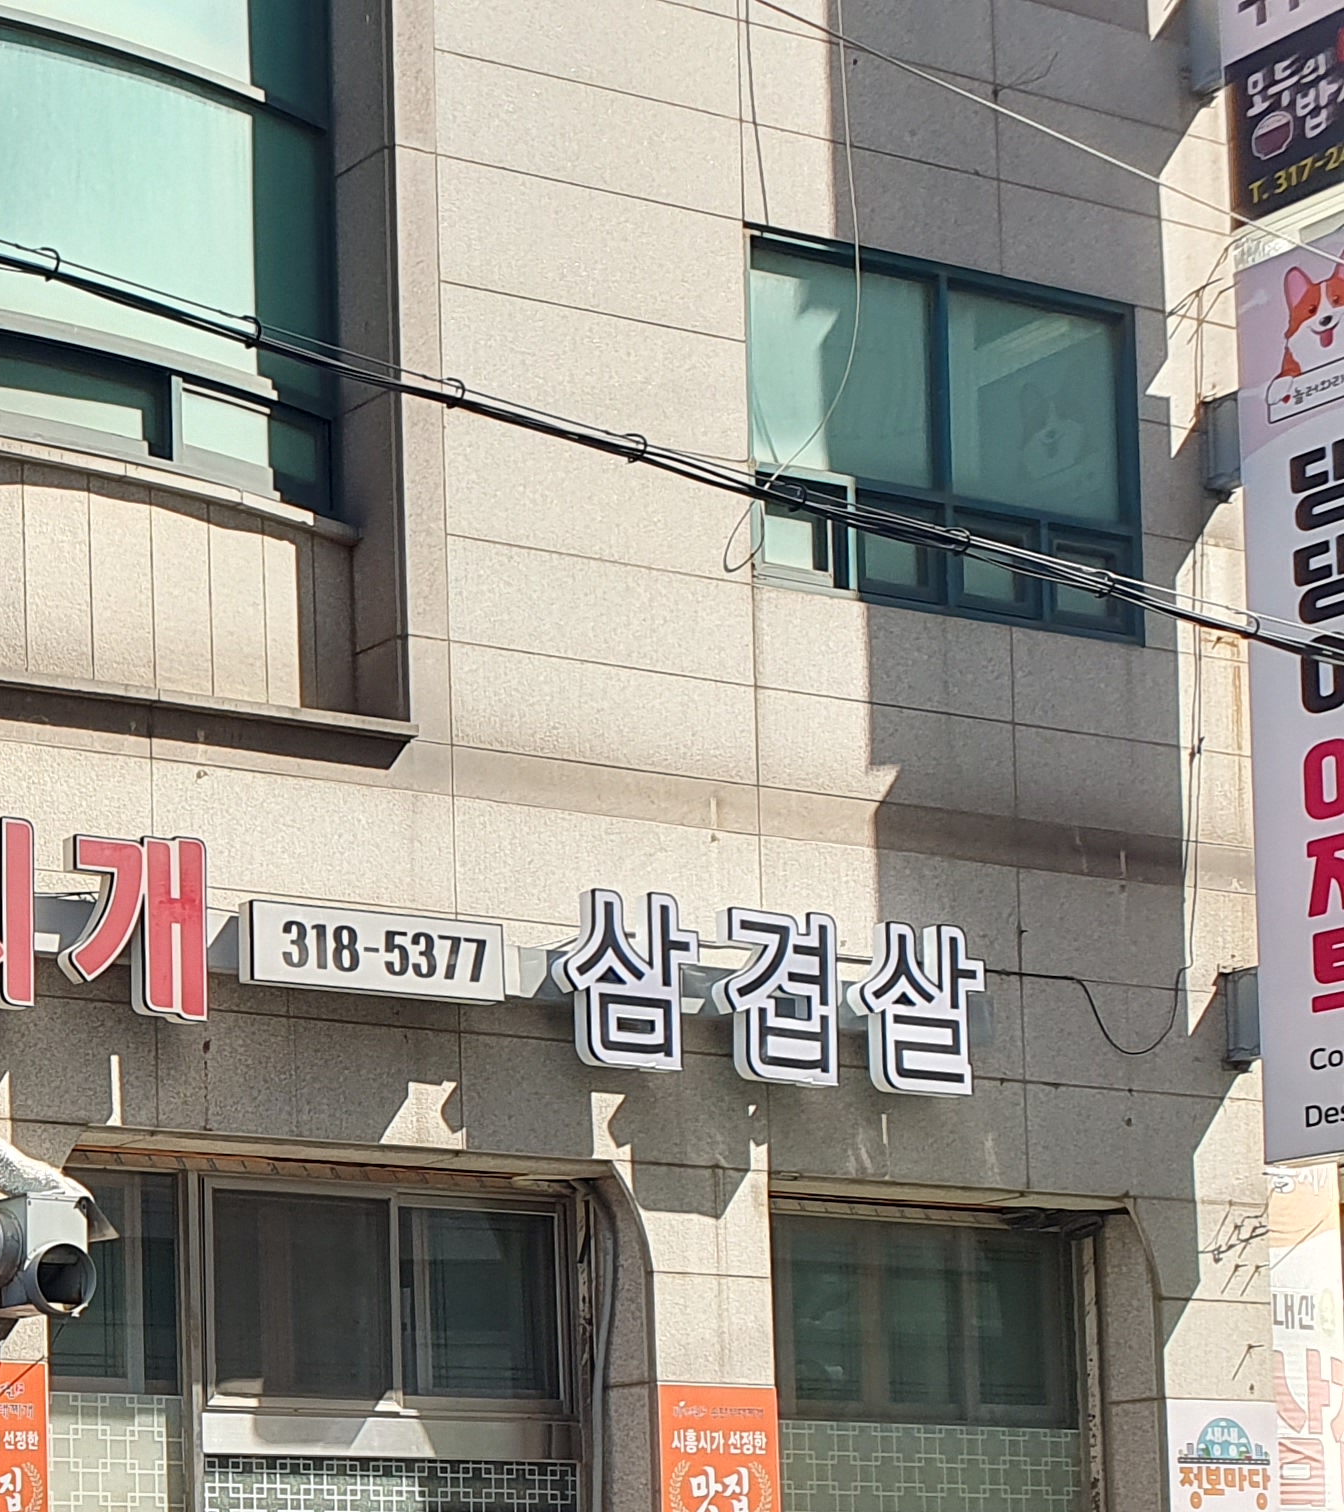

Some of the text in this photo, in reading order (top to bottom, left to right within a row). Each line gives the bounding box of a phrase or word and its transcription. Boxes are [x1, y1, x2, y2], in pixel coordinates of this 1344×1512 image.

[280, 918, 488, 984] 318-5377
[554, 888, 988, 1096] 삼겹살
[3, 1430, 39, 1450] 선정한
[672, 1429, 767, 1455] 시흥시가 선정한
[1179, 1466, 1271, 1510] 정보마당
